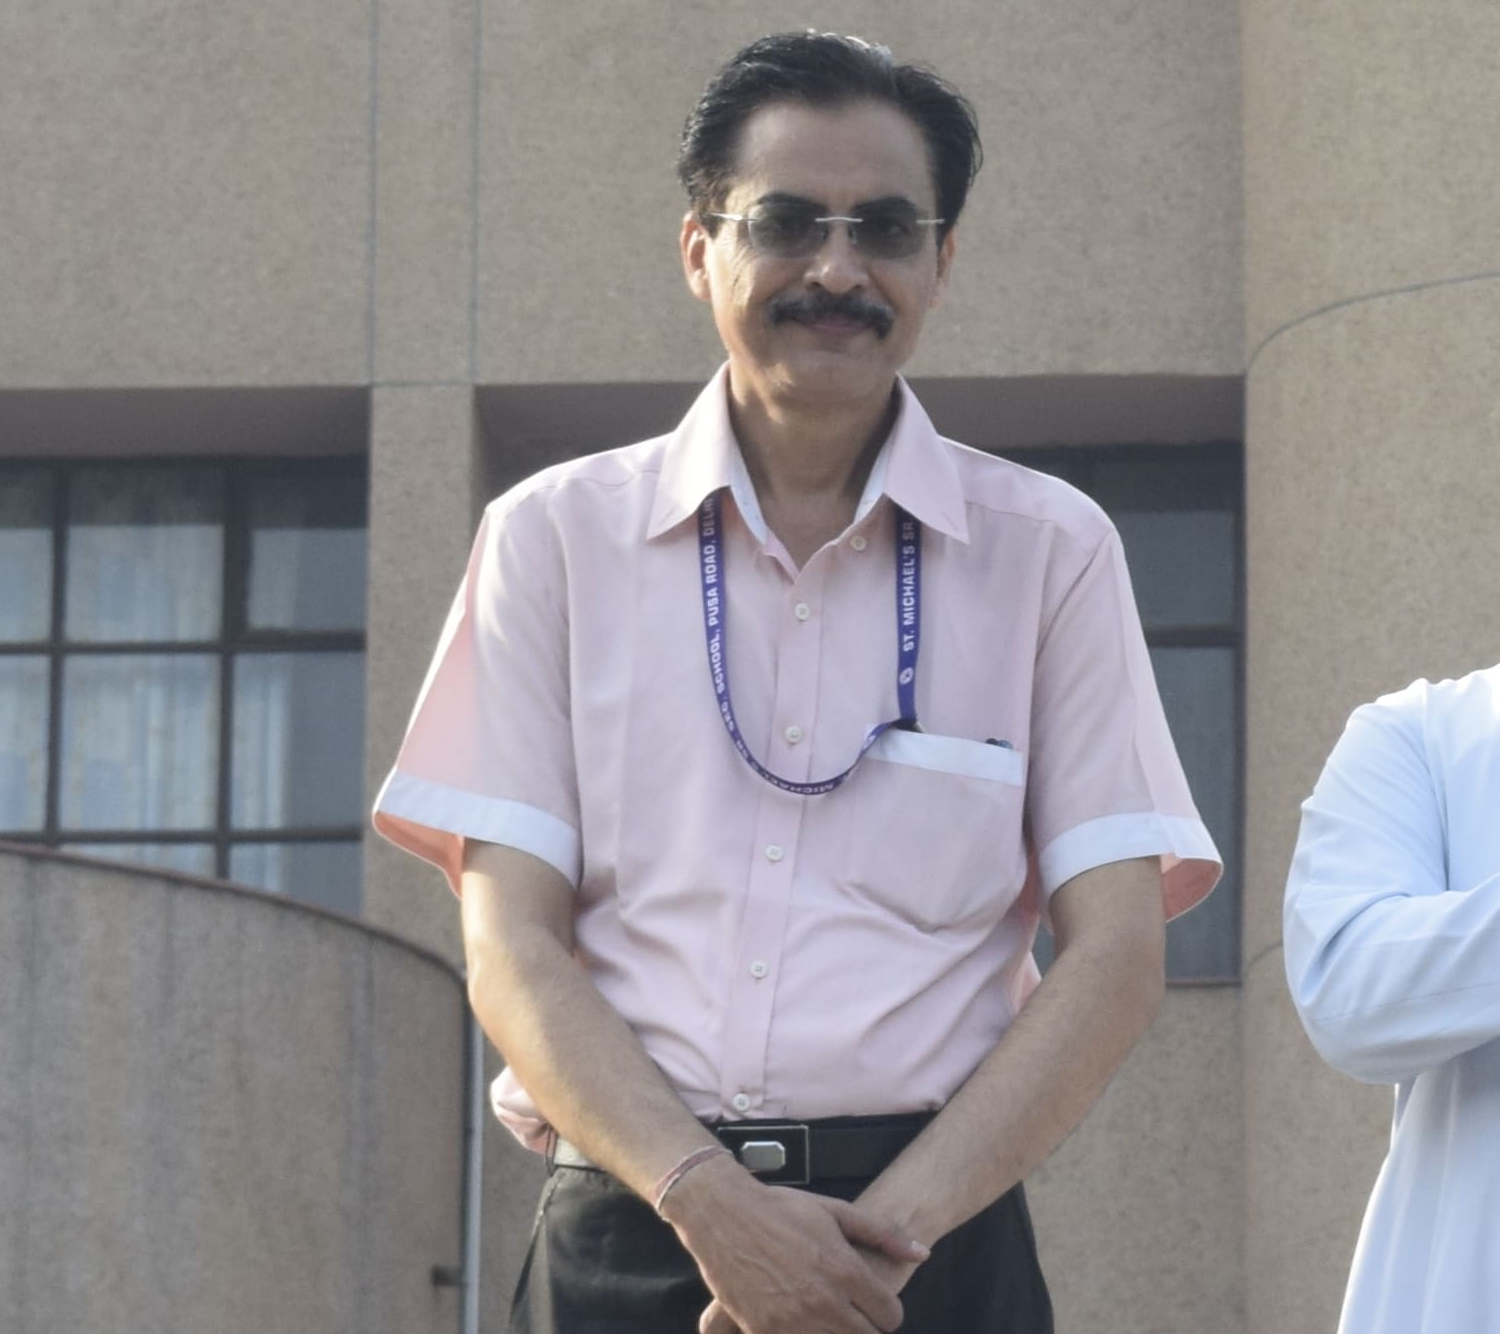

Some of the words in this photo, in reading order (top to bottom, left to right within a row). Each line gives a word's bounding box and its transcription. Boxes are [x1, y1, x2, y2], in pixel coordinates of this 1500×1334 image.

[902, 545, 915, 626] MICHAEL'S
[707, 586, 719, 627] PUSA
[903, 629, 915, 652] ST.
